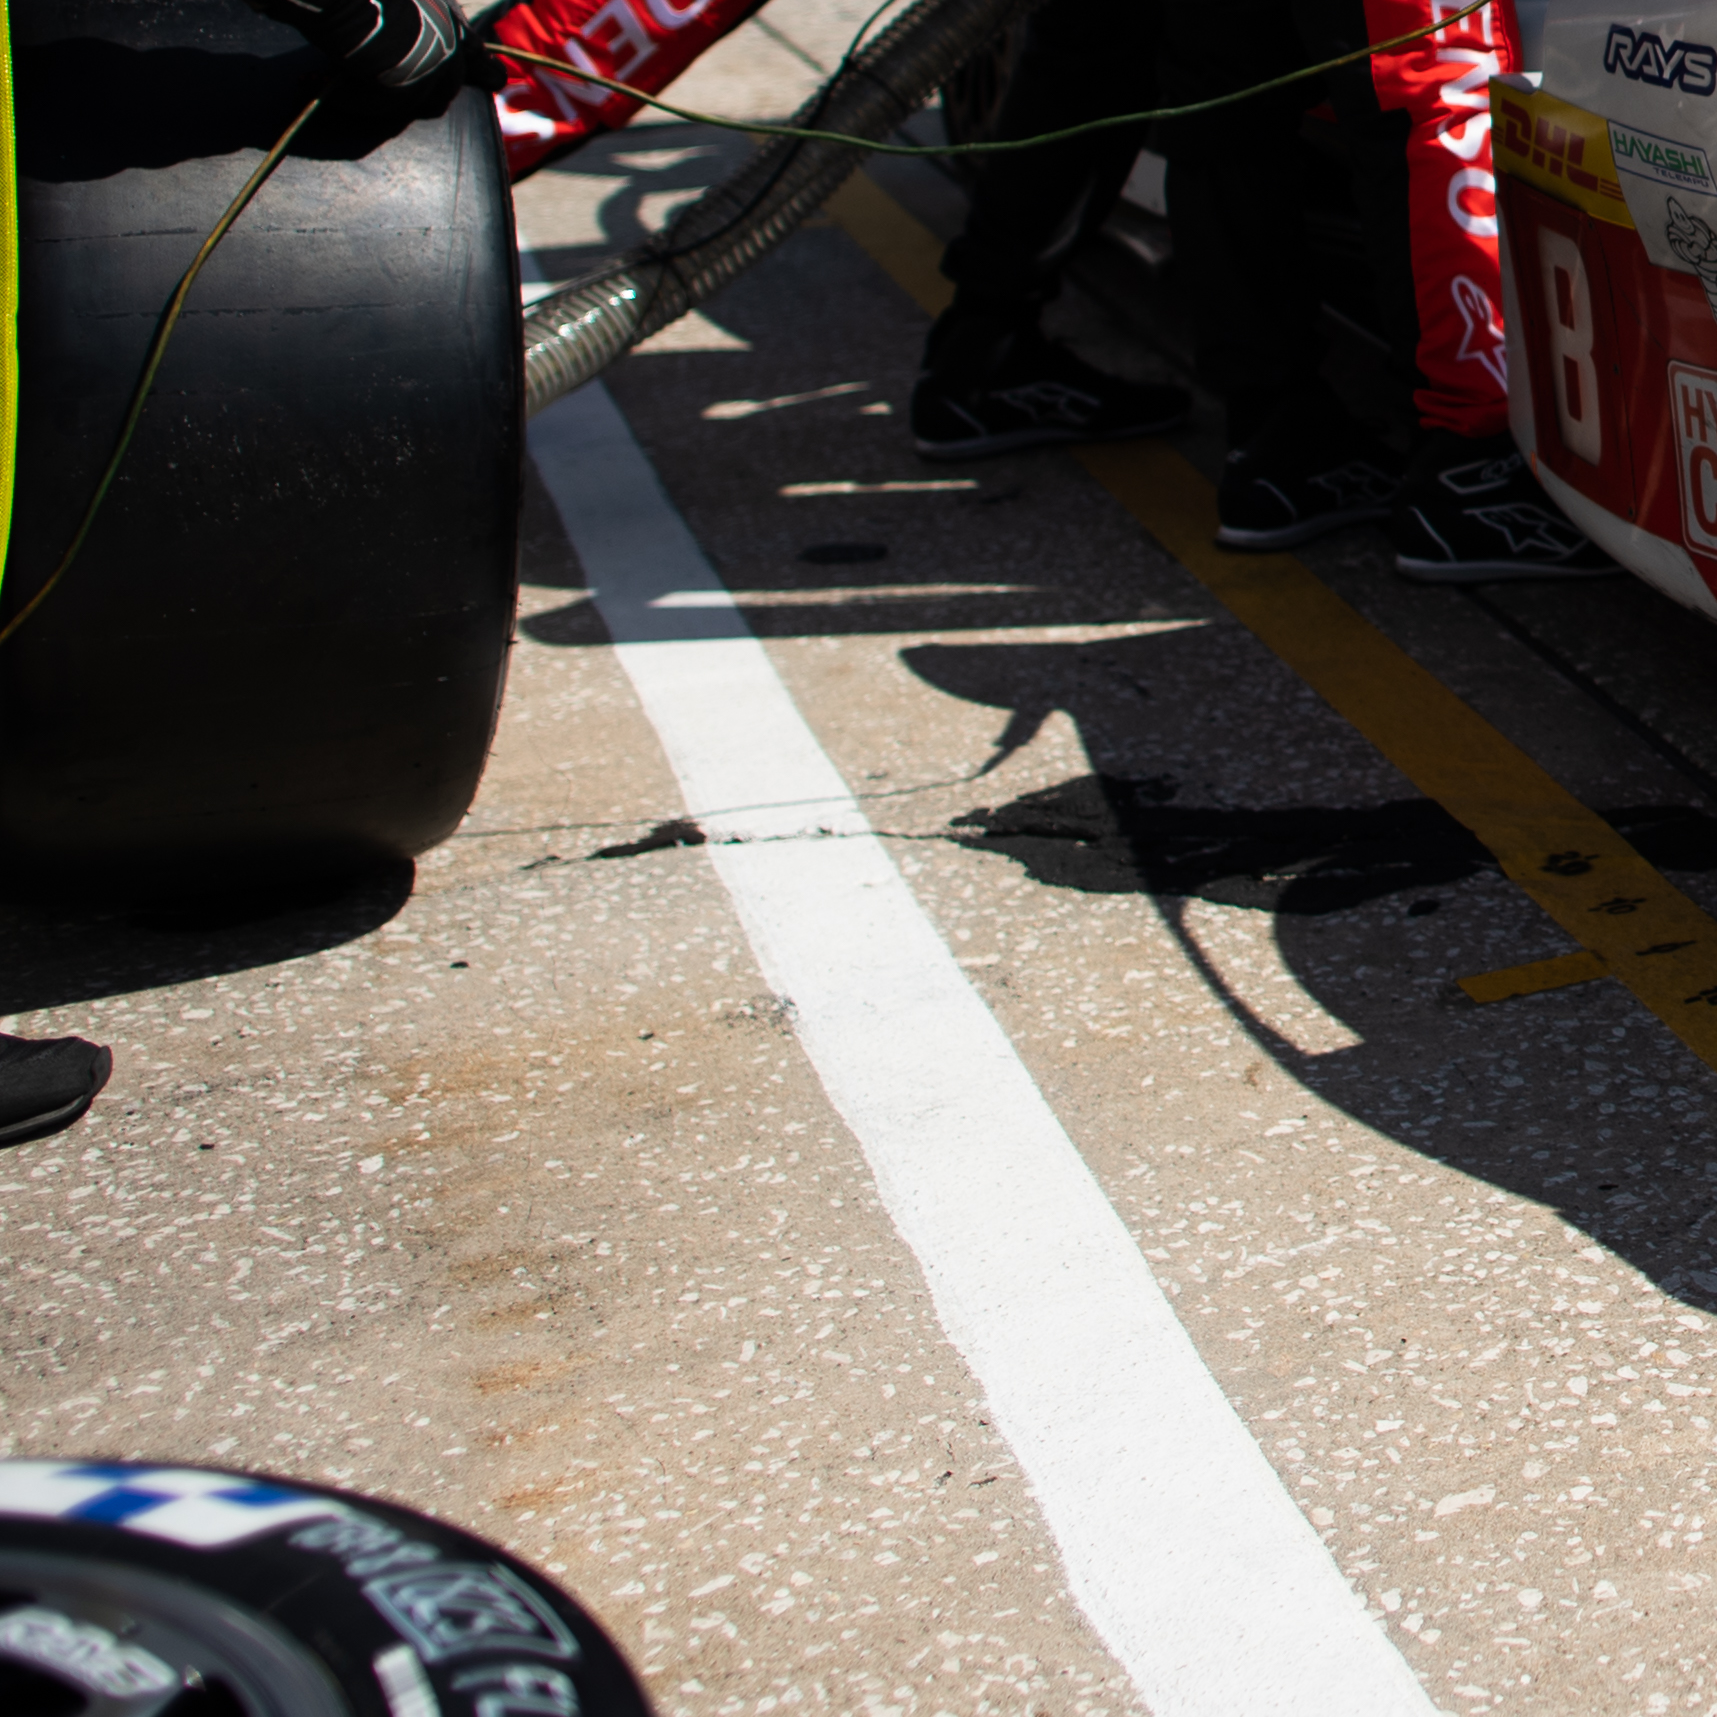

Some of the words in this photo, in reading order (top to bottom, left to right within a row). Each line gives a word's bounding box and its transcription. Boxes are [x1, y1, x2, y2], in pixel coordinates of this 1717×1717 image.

[1606, 30, 1713, 89] RAYS
[1500, 98, 1600, 193] DHL
[1612, 130, 1709, 179] HAYASHI
[1653, 167, 1710, 188] TELEMPU
[1538, 226, 1602, 468] 8
